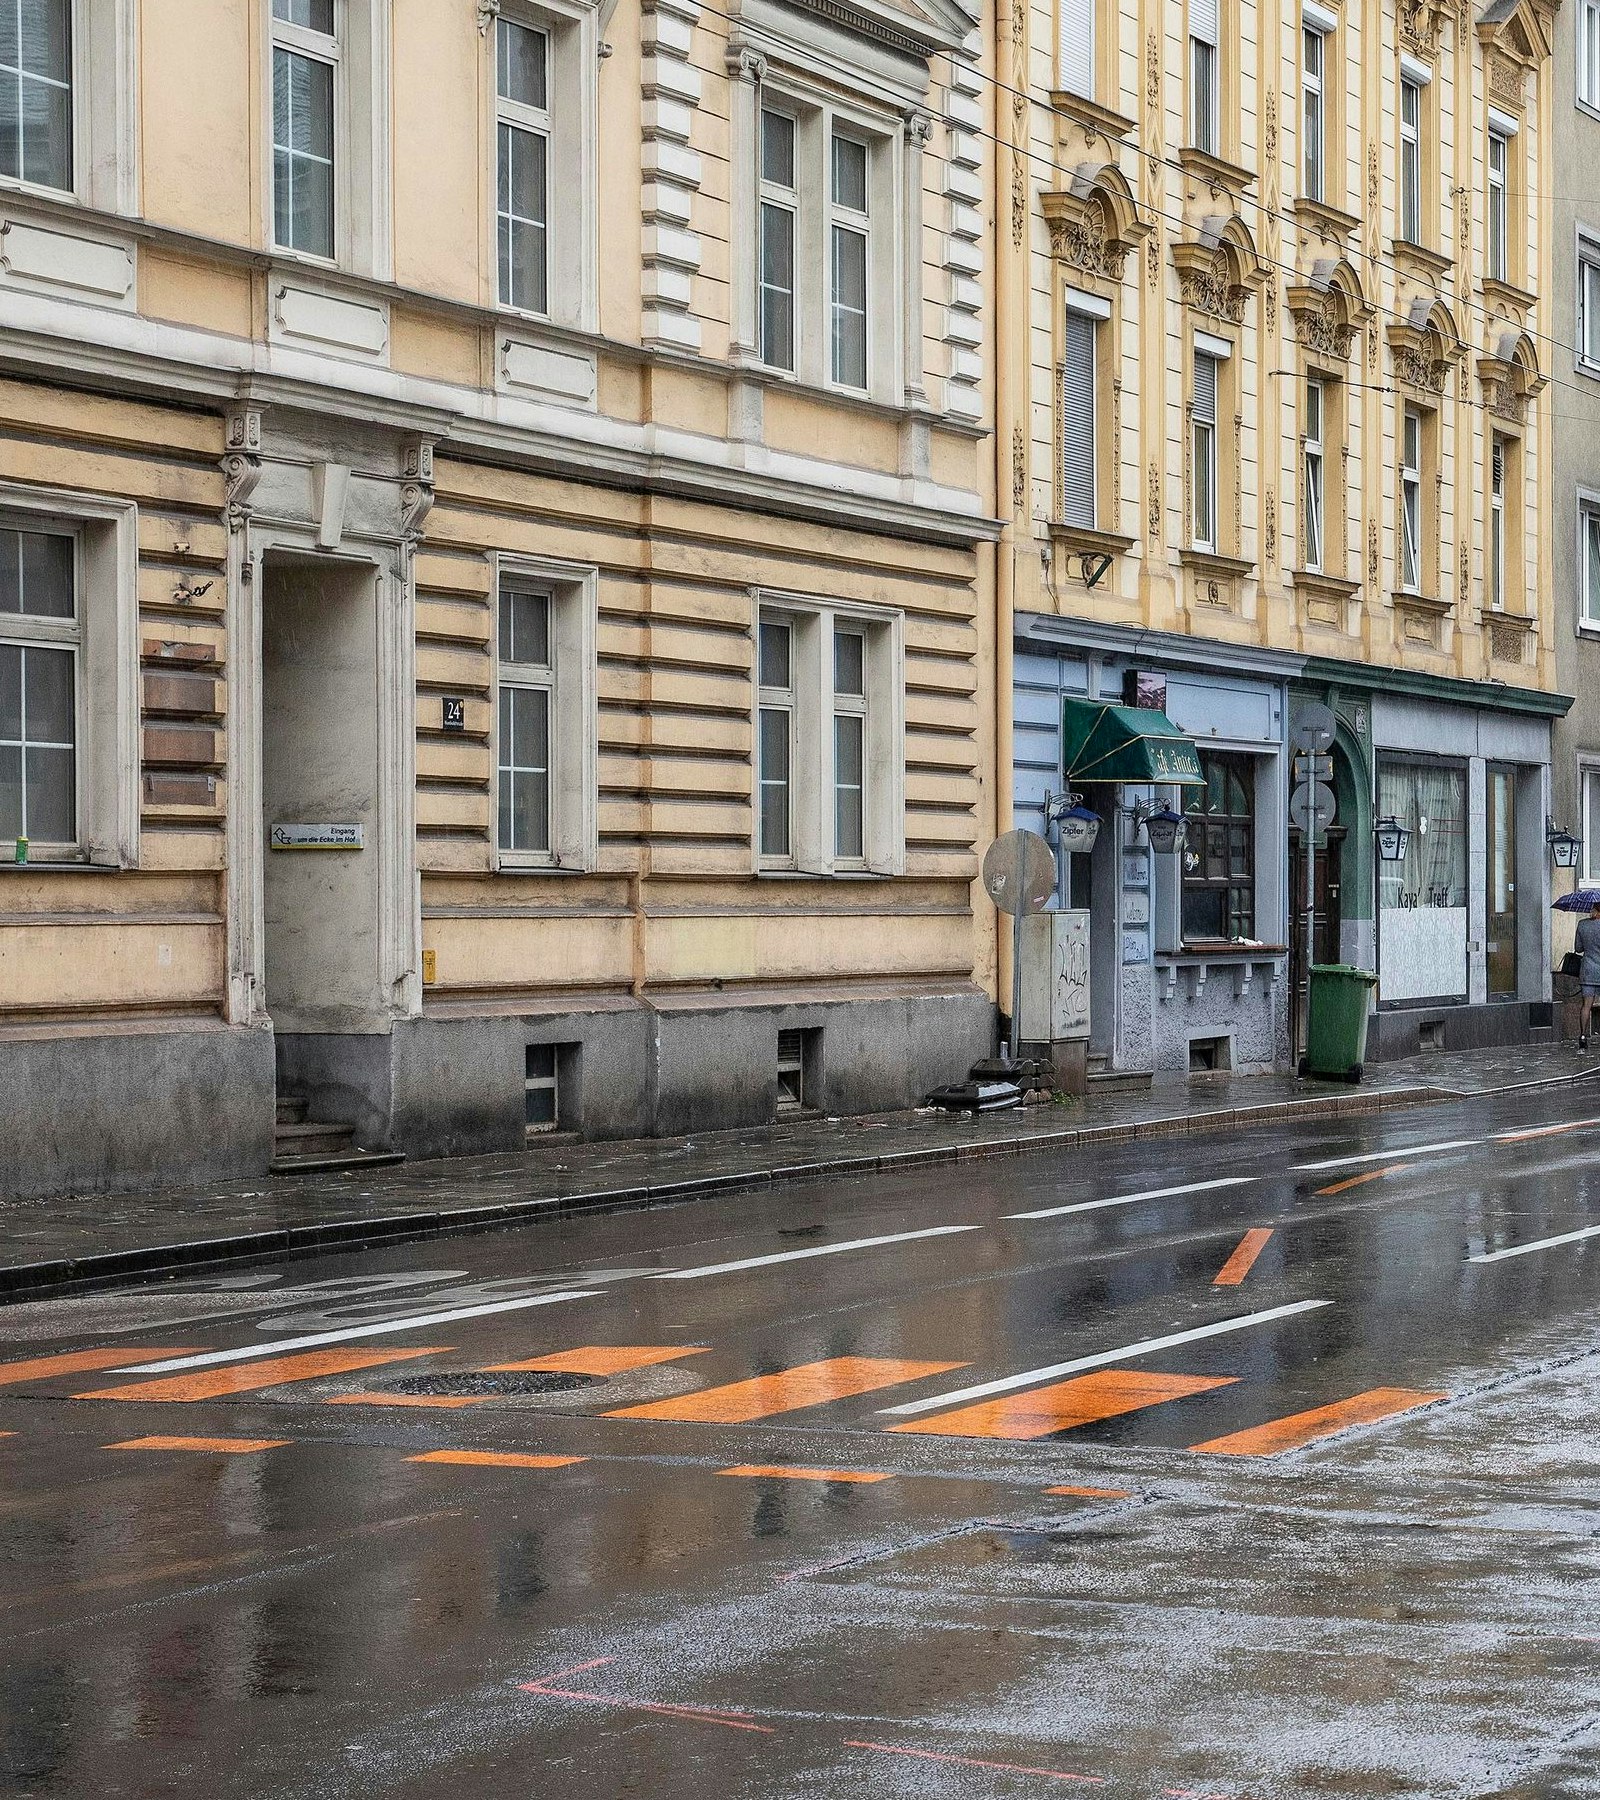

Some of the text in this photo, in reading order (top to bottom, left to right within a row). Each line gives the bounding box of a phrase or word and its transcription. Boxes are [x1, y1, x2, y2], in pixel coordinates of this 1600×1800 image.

[448, 702, 460, 719] 24
[331, 827, 355, 836] Eingang
[1062, 826, 1084, 836] Zipfer
[1428, 887, 1449, 908] Treff
